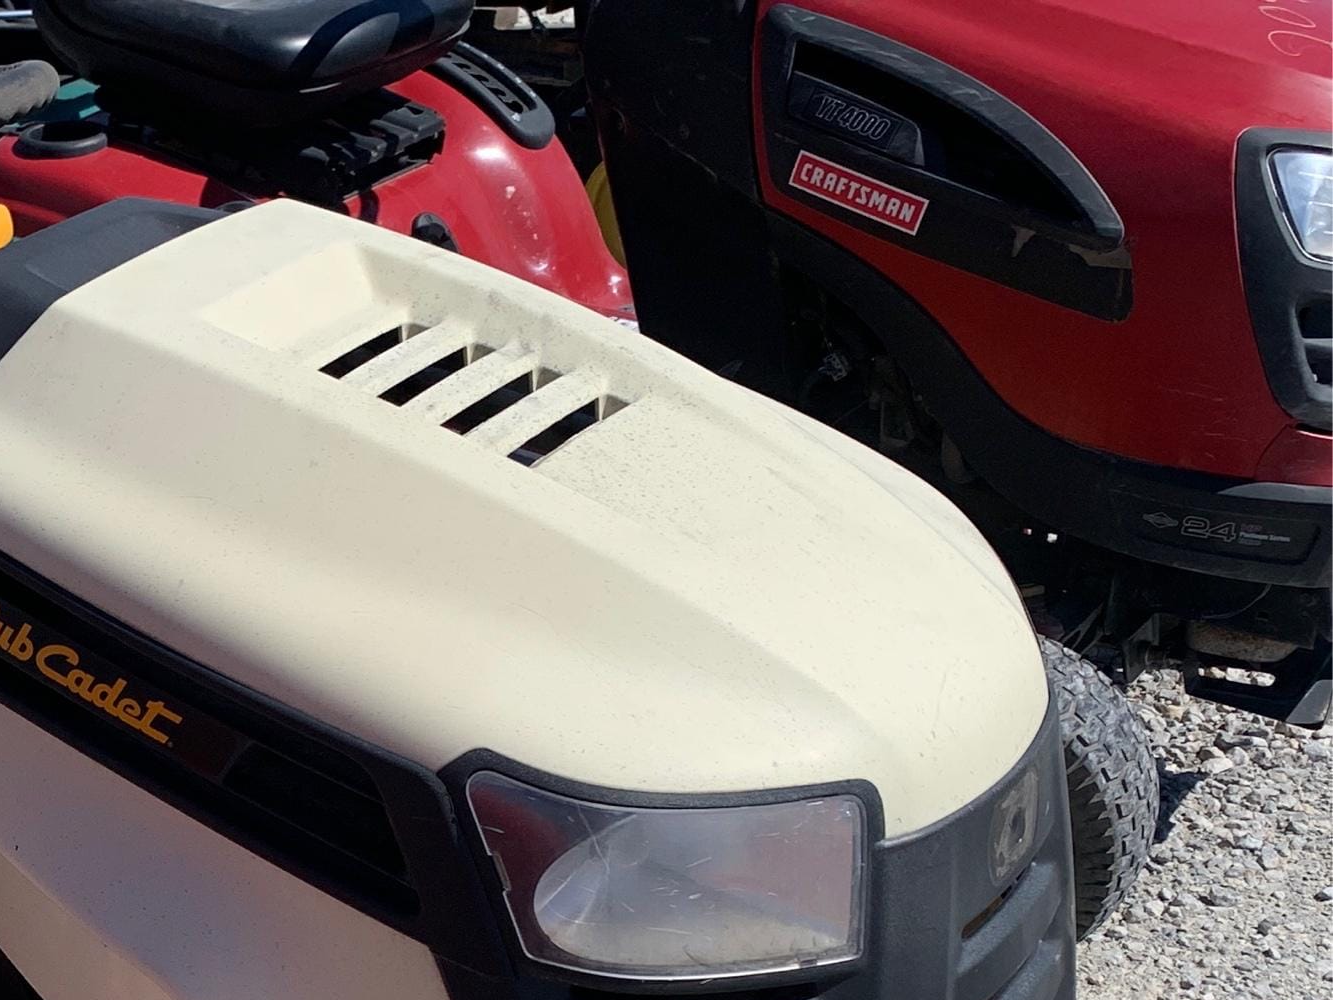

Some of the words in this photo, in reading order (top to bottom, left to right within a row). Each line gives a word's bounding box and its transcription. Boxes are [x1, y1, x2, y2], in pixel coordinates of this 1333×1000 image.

[816, 95, 846, 122] YT
[838, 105, 891, 140] 4000
[799, 162, 916, 223] CRAFTSMAN
[1181, 515, 1236, 542] 24
[35, 643, 183, 744] Cadet
